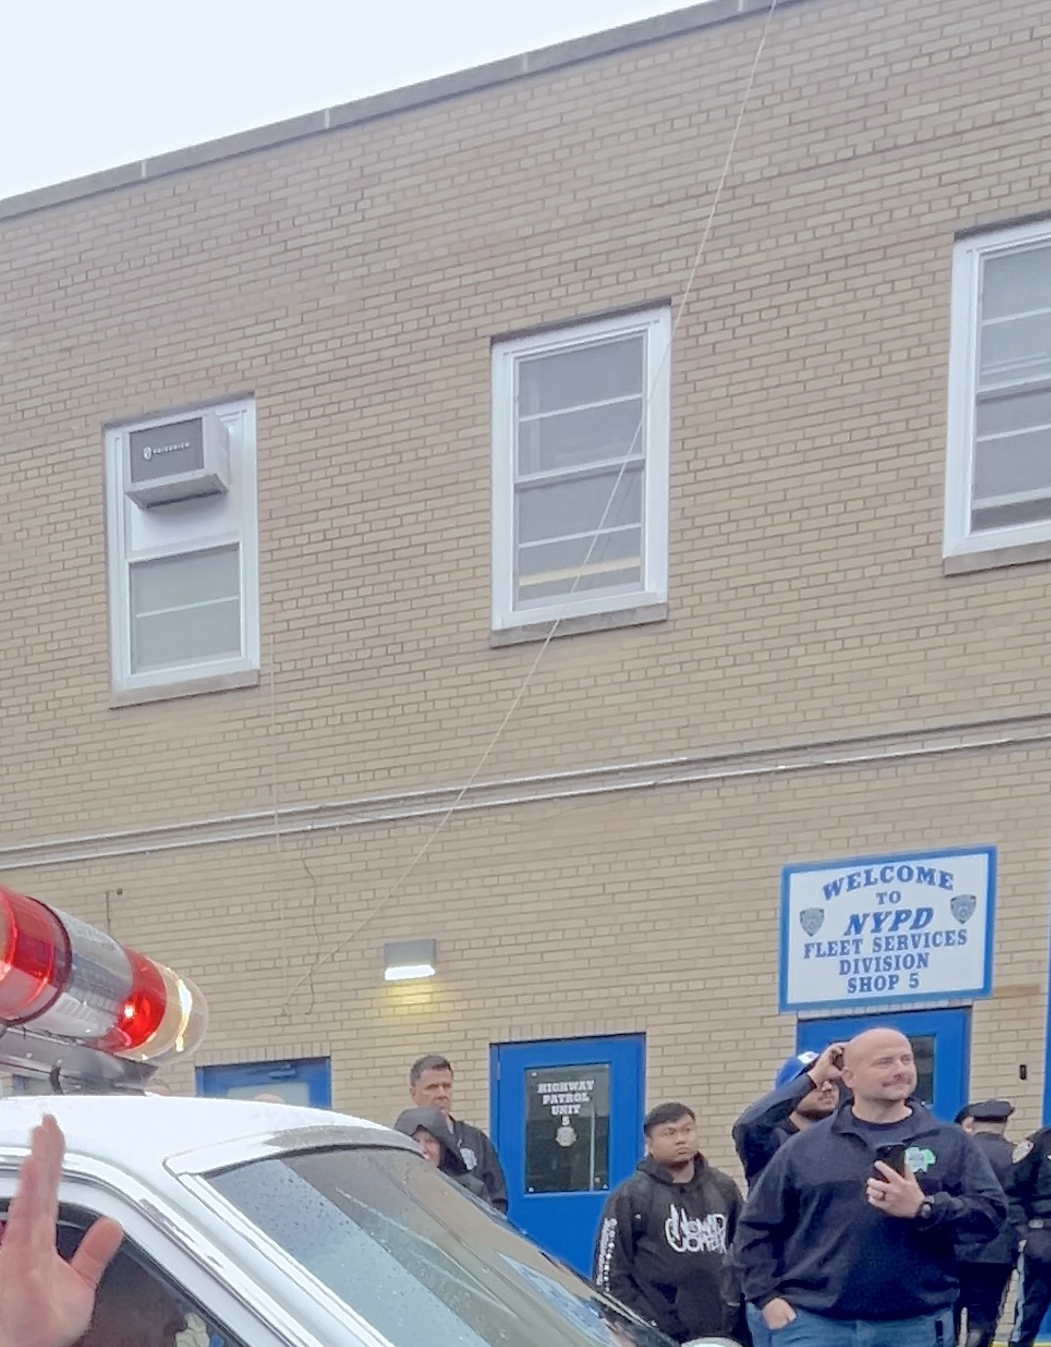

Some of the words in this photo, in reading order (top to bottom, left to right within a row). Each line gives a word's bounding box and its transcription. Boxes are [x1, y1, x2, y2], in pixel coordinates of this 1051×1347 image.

[822, 865, 954, 901] WELCOME
[876, 890, 901, 905] TO
[843, 907, 934, 936] NYPD
[803, 938, 864, 959] FLEET
[872, 929, 968, 953] SERVICES
[838, 952, 930, 976] DIVISION
[847, 973, 900, 994] SHOP
[909, 972, 920, 989] 5
[537, 1080, 595, 1094] HIGHWAY
[542, 1092, 590, 1105] PATROL
[551, 1104, 581, 1116] UNIT
